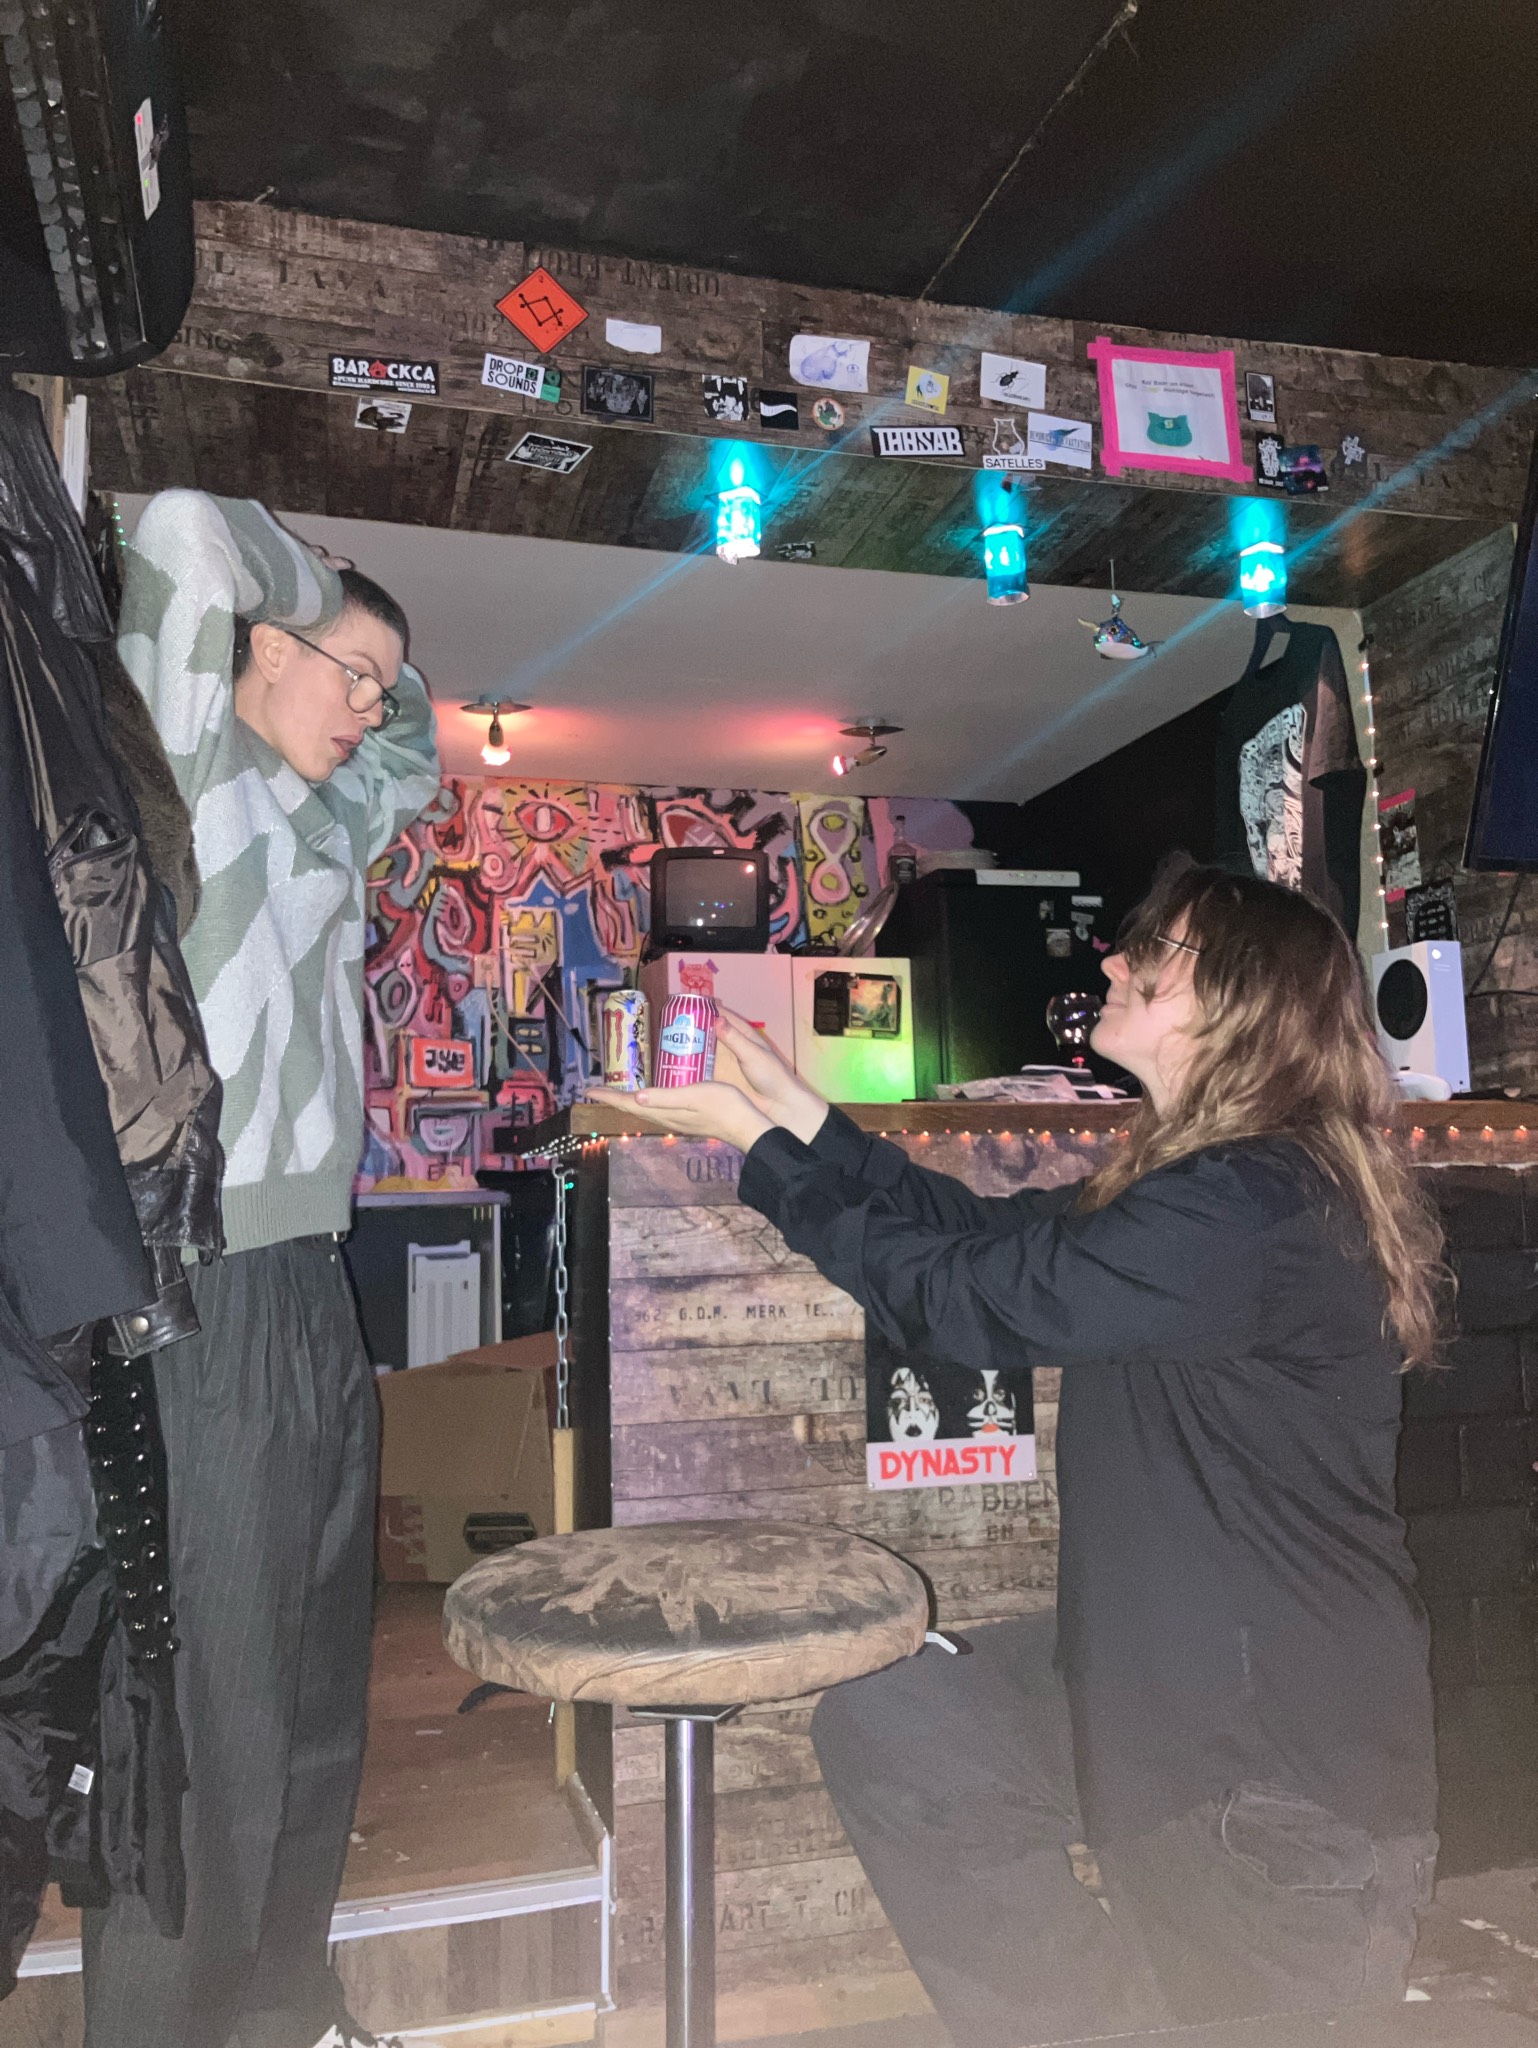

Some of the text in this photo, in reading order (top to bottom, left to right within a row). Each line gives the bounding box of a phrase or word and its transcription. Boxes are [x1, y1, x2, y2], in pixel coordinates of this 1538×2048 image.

[489, 358, 524, 376] DROP
[487, 371, 537, 394] SOUNDS
[985, 458, 1044, 469] SATELLES
[746, 1304, 787, 1319] MERK
[879, 1445, 1017, 1483] DYNASTY
